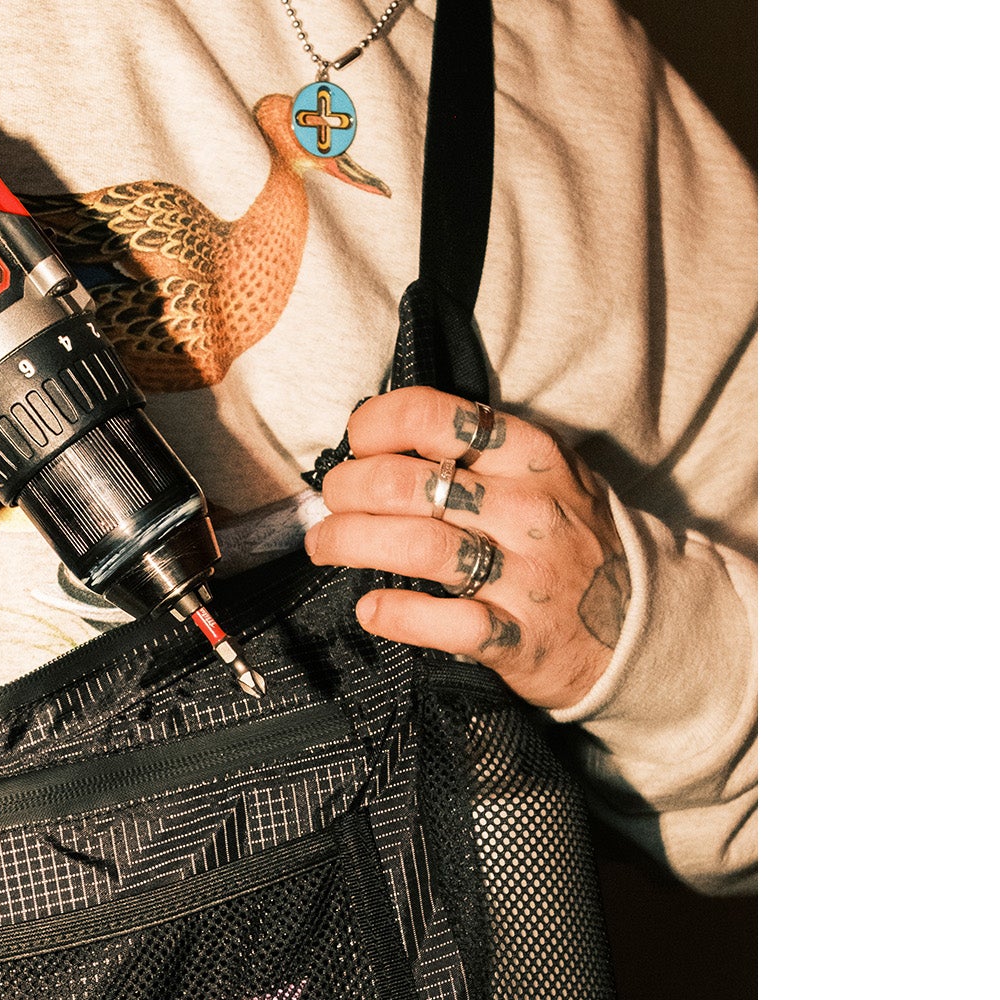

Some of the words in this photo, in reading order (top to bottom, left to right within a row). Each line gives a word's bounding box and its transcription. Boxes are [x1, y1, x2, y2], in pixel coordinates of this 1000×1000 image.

[86, 321, 101, 338] 2
[57, 335, 73, 352] 4
[18, 359, 36, 378] 6
